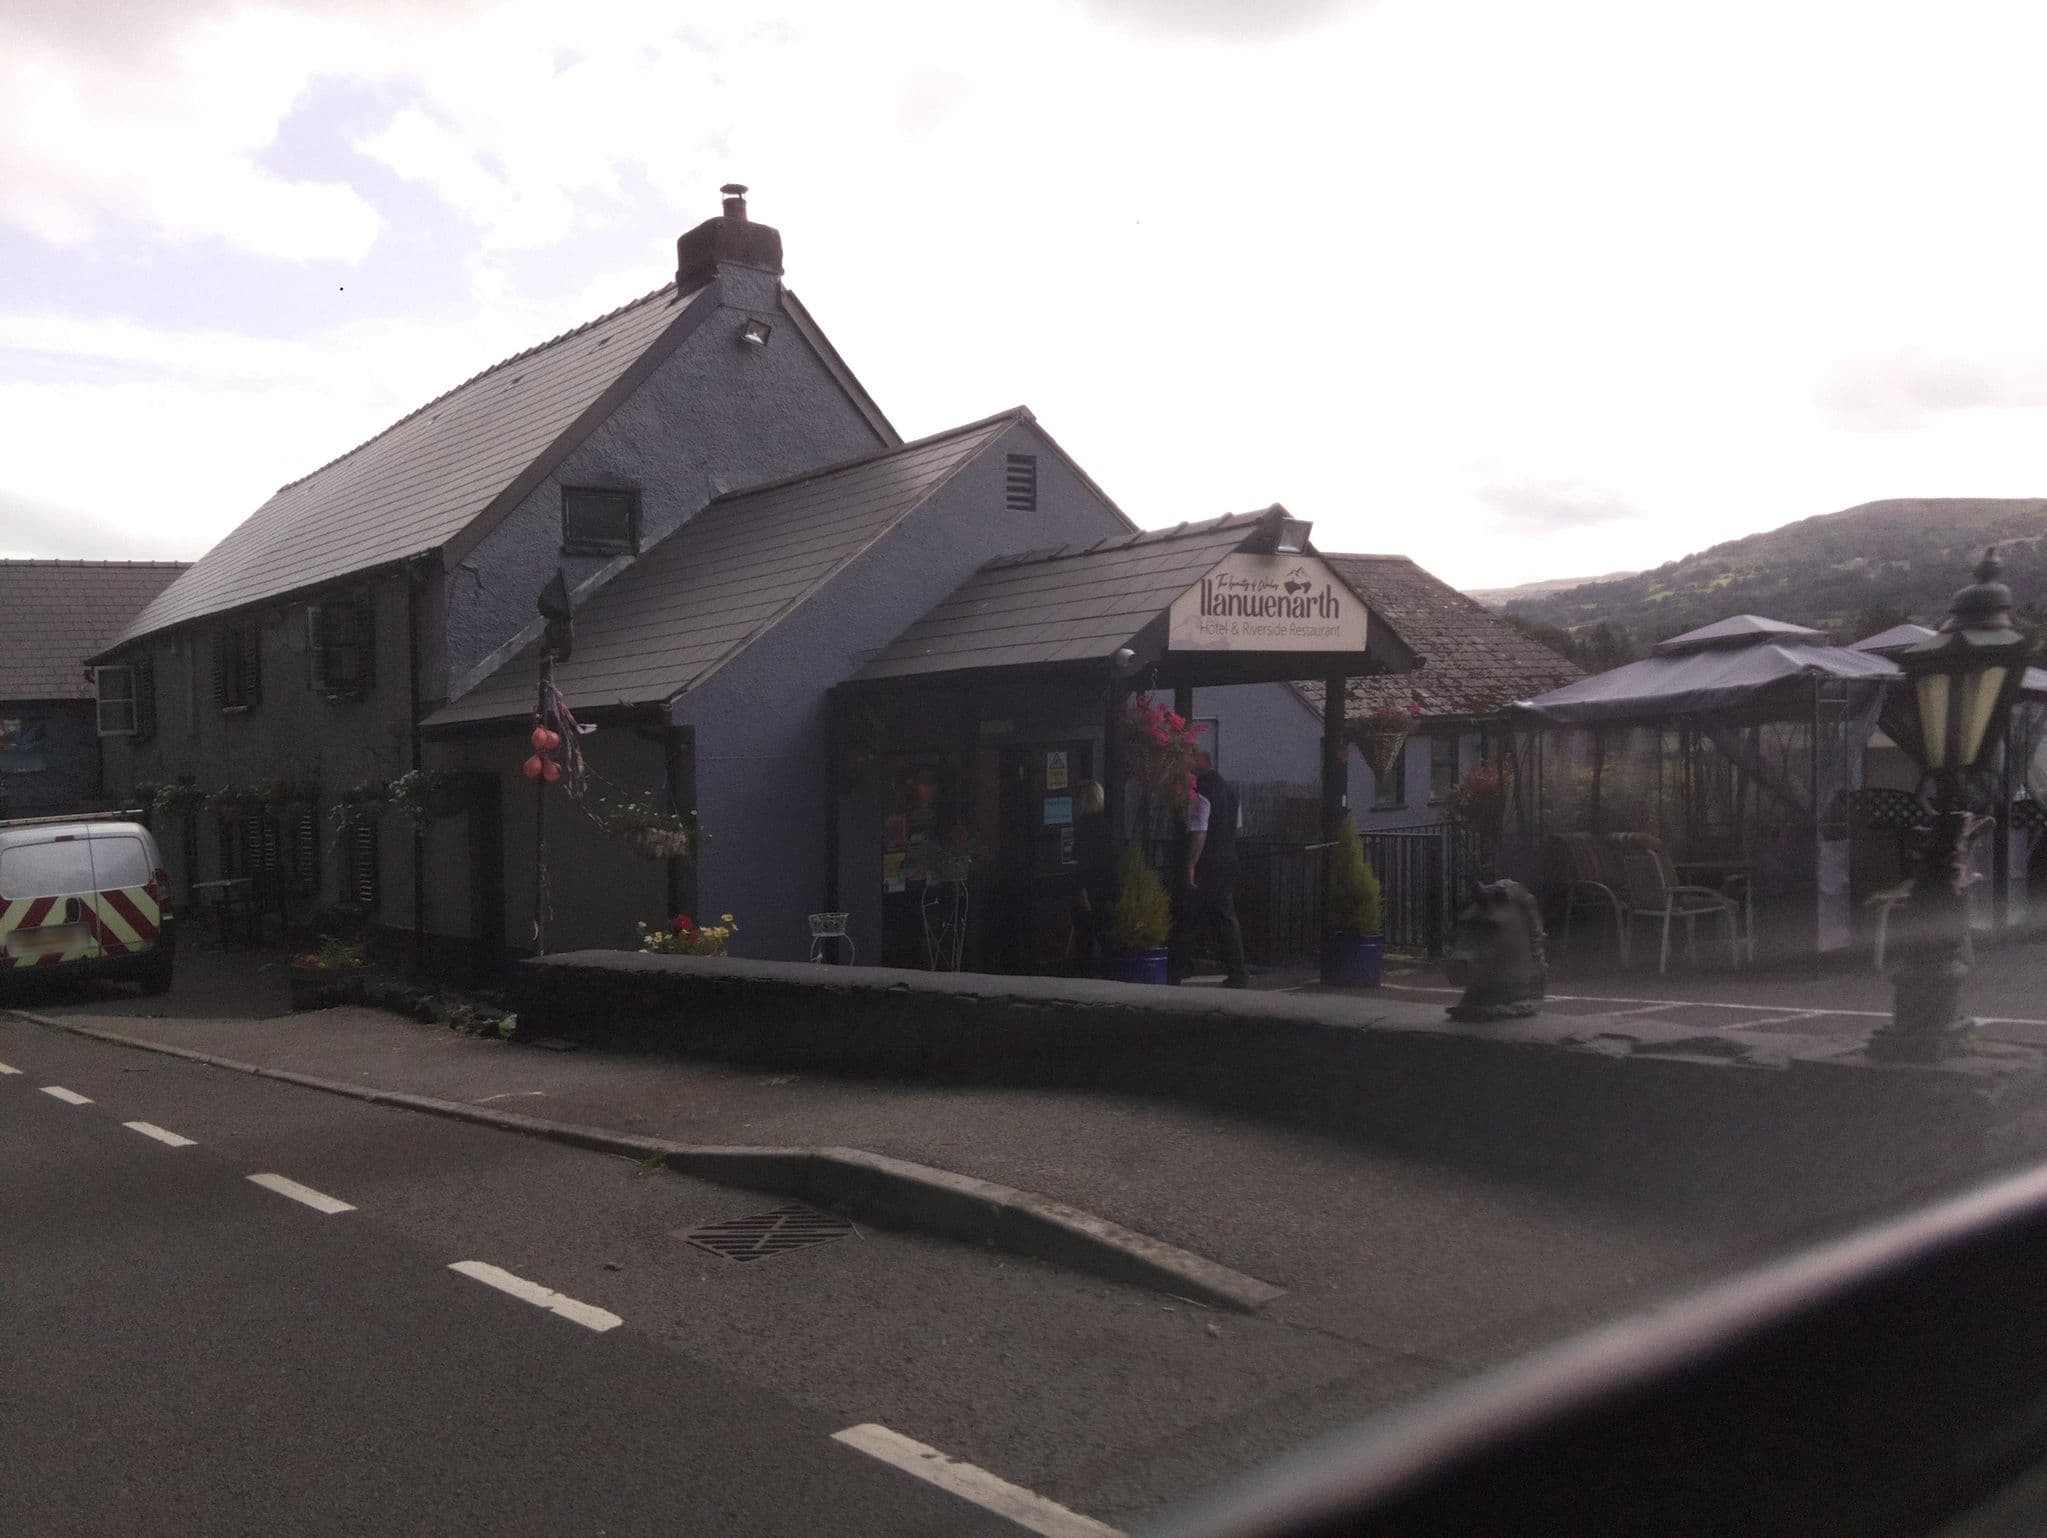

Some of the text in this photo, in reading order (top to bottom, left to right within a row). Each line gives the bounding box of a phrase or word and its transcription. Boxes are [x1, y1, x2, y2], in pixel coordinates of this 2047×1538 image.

[1200, 578, 1339, 619] llanwenarth
[1200, 621, 1340, 637] Hotel & Riverside Restaurant
